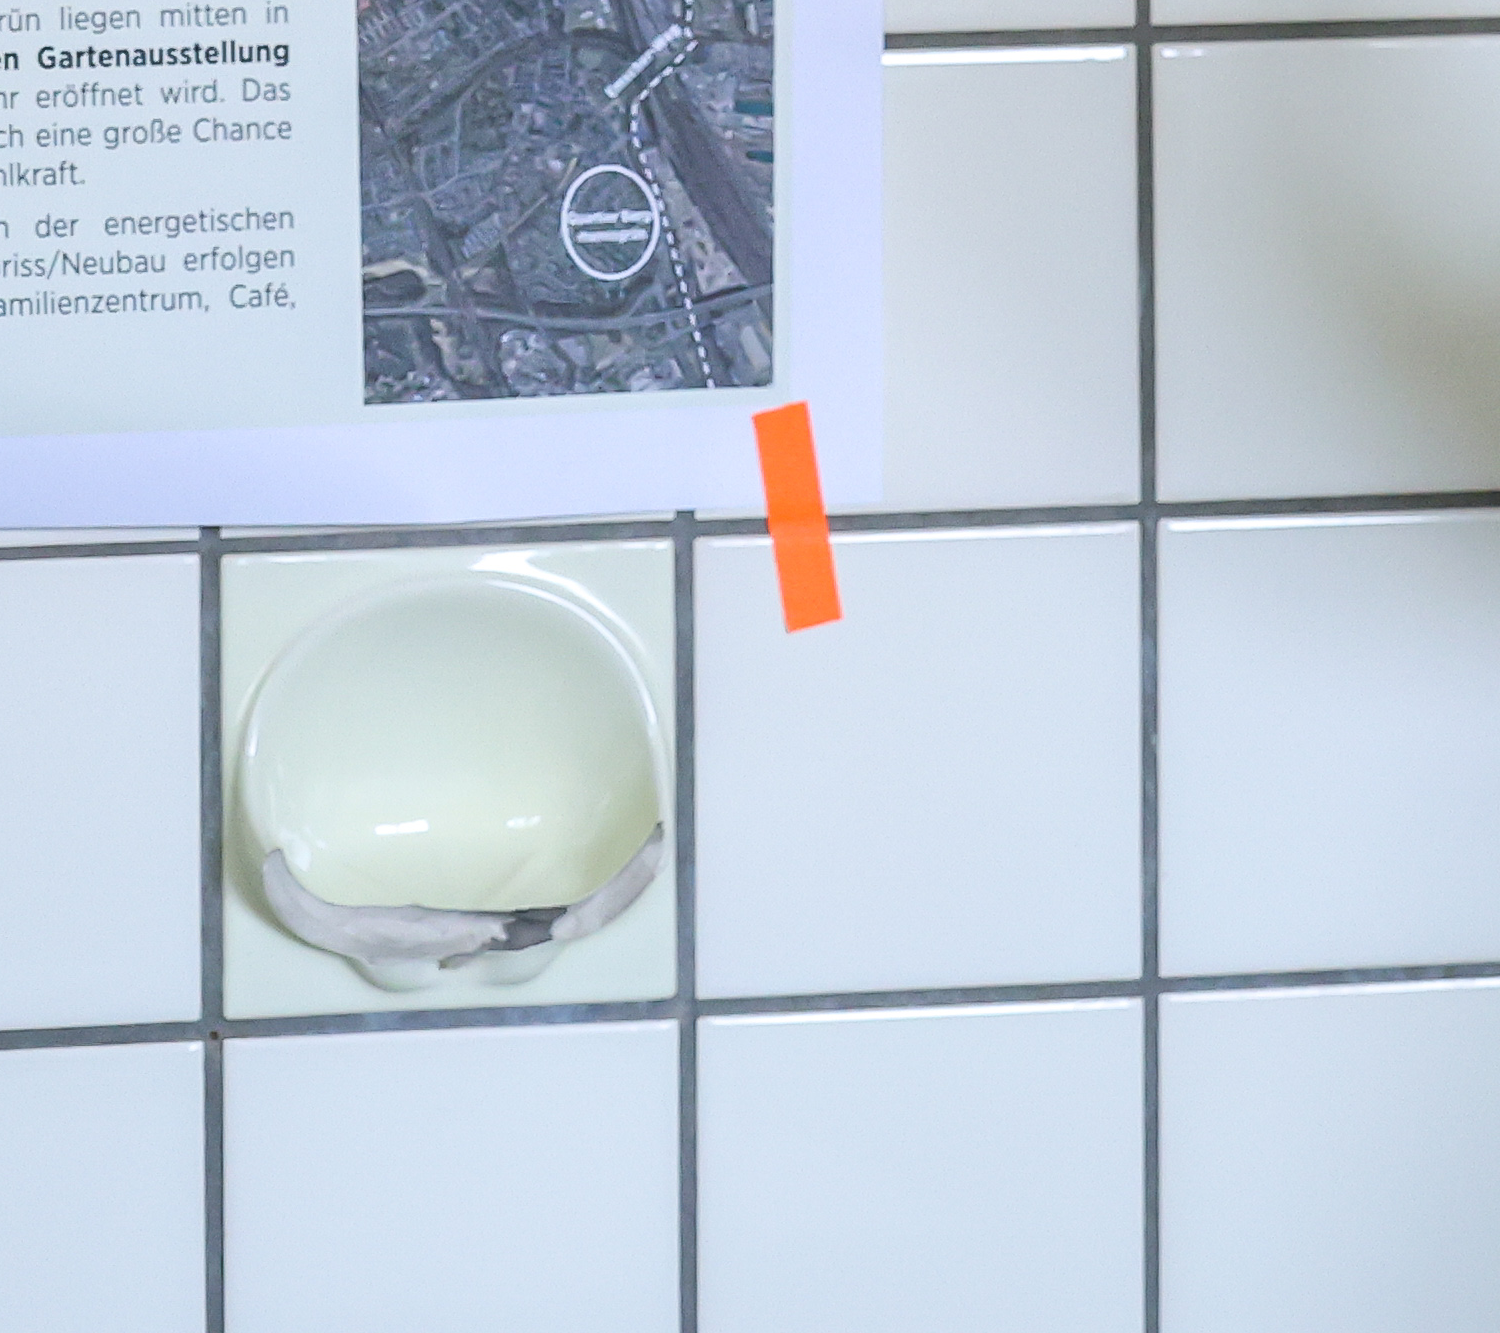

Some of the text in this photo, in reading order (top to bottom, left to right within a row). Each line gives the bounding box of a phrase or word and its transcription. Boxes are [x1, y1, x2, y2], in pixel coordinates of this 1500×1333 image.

[60, 6, 141, 35] liegen
[160, 4, 247, 27] mitten
[266, 5, 288, 23] in
